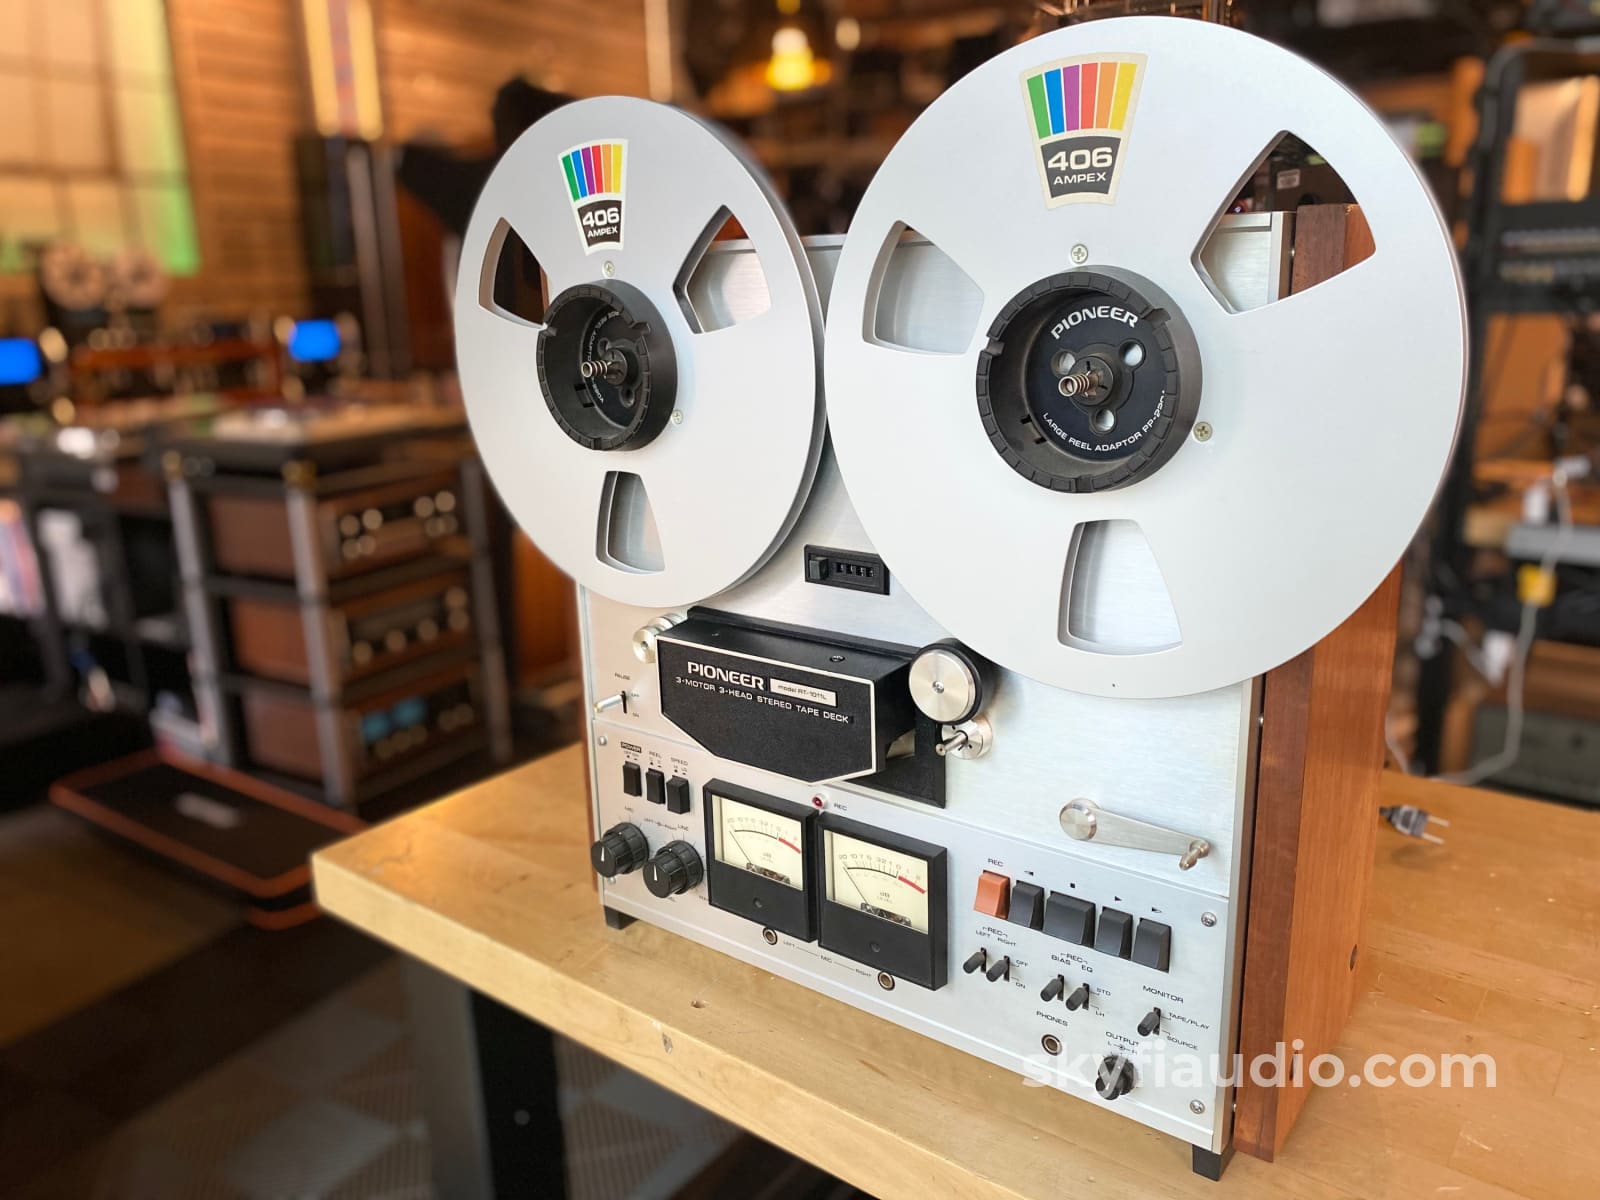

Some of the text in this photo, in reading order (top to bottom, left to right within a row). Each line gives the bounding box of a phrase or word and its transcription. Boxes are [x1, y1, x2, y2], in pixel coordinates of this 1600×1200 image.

[1047, 146, 1113, 171] 406
[1053, 171, 1107, 185] AMPEX
[582, 207, 620, 228] 406
[587, 226, 618, 238] AMPEX
[1050, 305, 1139, 340] PIONEER
[1043, 412, 1068, 440] LARGE
[1068, 437, 1093, 452] REEL
[1094, 431, 1142, 452] ADAPTOR
[686, 661, 765, 692] PIONEER
[778, 684, 797, 694] model
[719, 686, 753, 701] 3-HEAD
[757, 695, 792, 710] STEREO
[796, 704, 820, 718] TAPE
[823, 711, 849, 724] DECK
[833, 802, 848, 811] REC
[987, 857, 1005, 867] REC
[975, 930, 1017, 947] LEFT RIGHT
[1015, 959, 1029, 968] OFF
[1051, 954, 1094, 973] BIAS EQ
[1096, 987, 1112, 997] STD
[1142, 985, 1185, 1005] MONITOR
[1036, 1010, 1069, 1027] PHONES
[1169, 1012, 1211, 1030] TAPE/PLAY
[1105, 1031, 1140, 1046] OUTPUT
[1166, 1035, 1199, 1051] SOURCE
